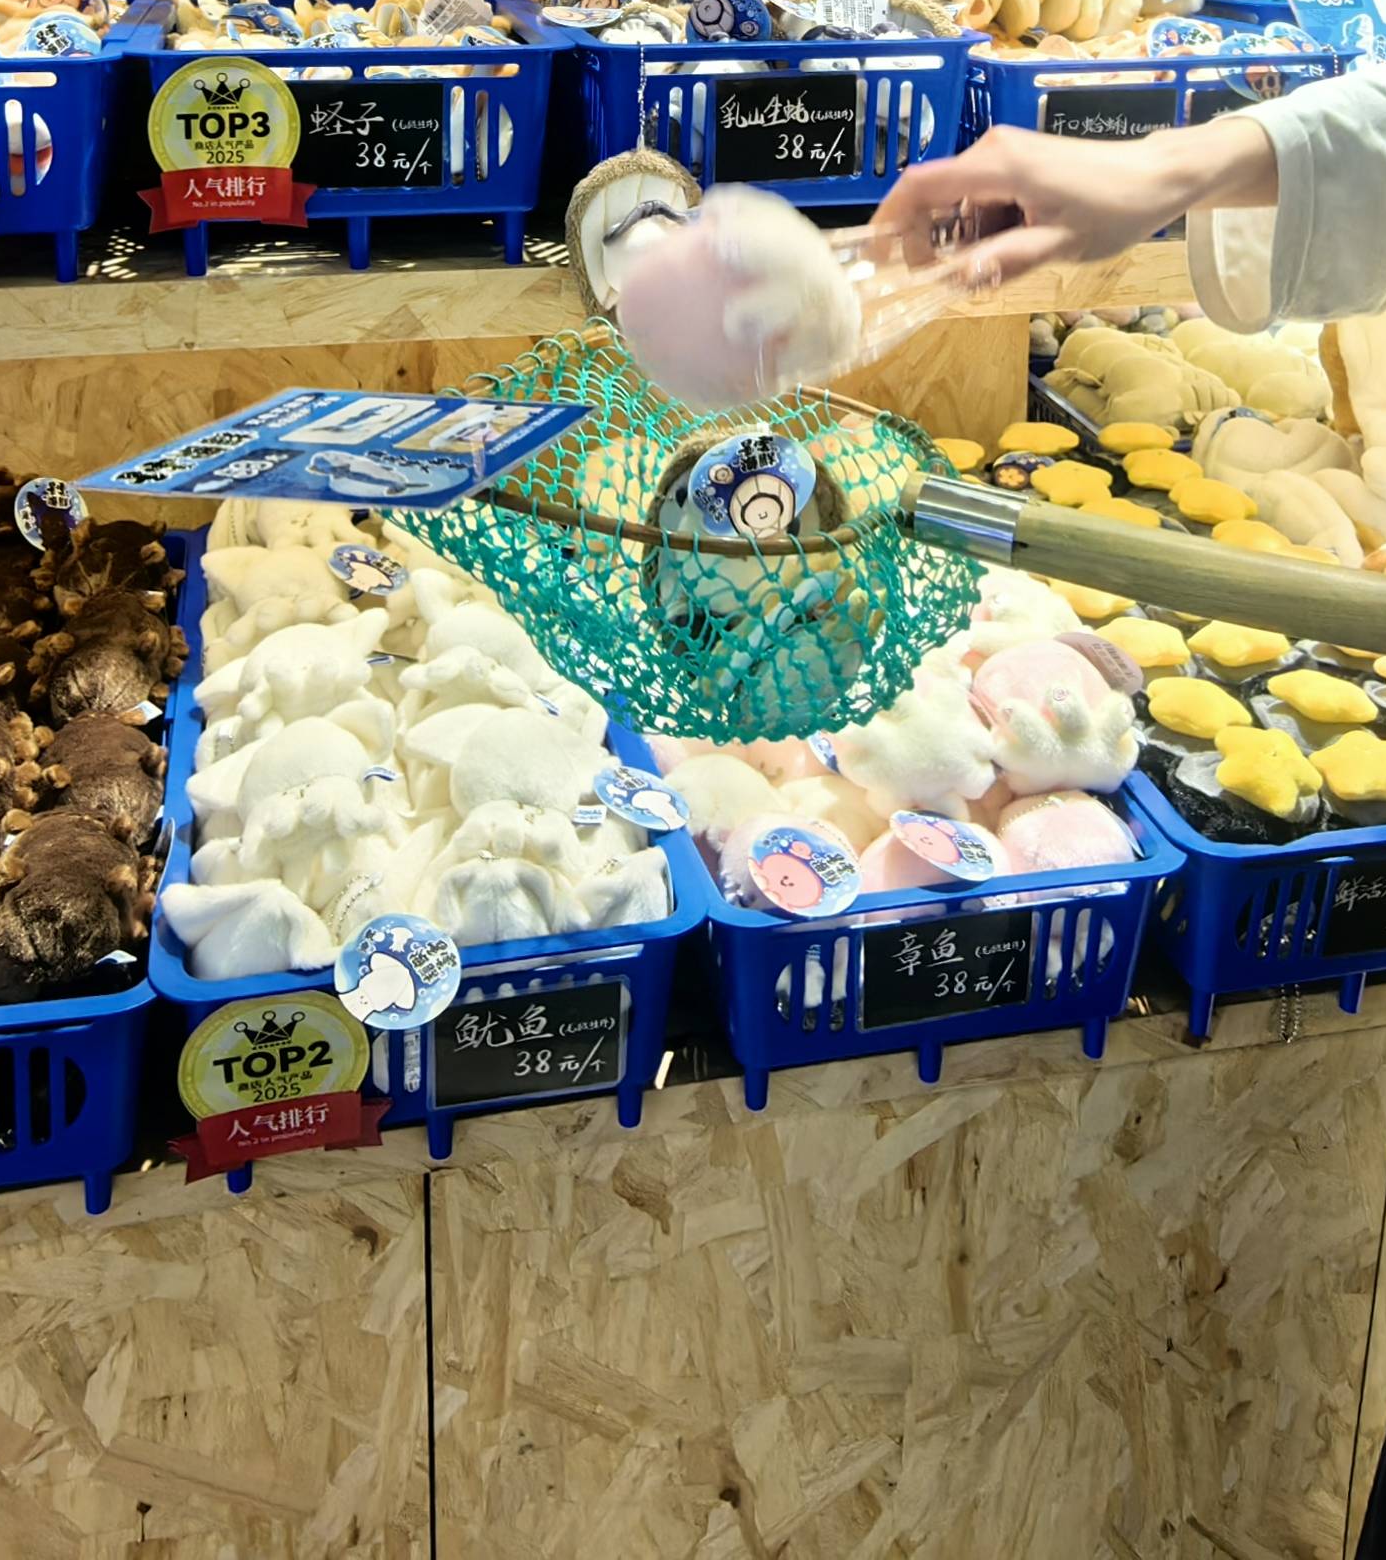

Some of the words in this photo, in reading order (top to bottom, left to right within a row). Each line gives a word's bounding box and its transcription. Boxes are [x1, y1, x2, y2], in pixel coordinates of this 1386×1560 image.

[176, 111, 271, 140] TOP3
[308, 100, 385, 137] 蛏子
[194, 140, 255, 151] 商店人气产品
[206, 150, 246, 165] 2025
[183, 176, 267, 199] 人气排行
[890, 927, 965, 977] 章鱼
[453, 1003, 555, 1053] 鱿鱼
[212, 1039, 334, 1084] TOP2
[253, 1083, 302, 1104] 2025
[227, 1102, 331, 1142] 人气排行
